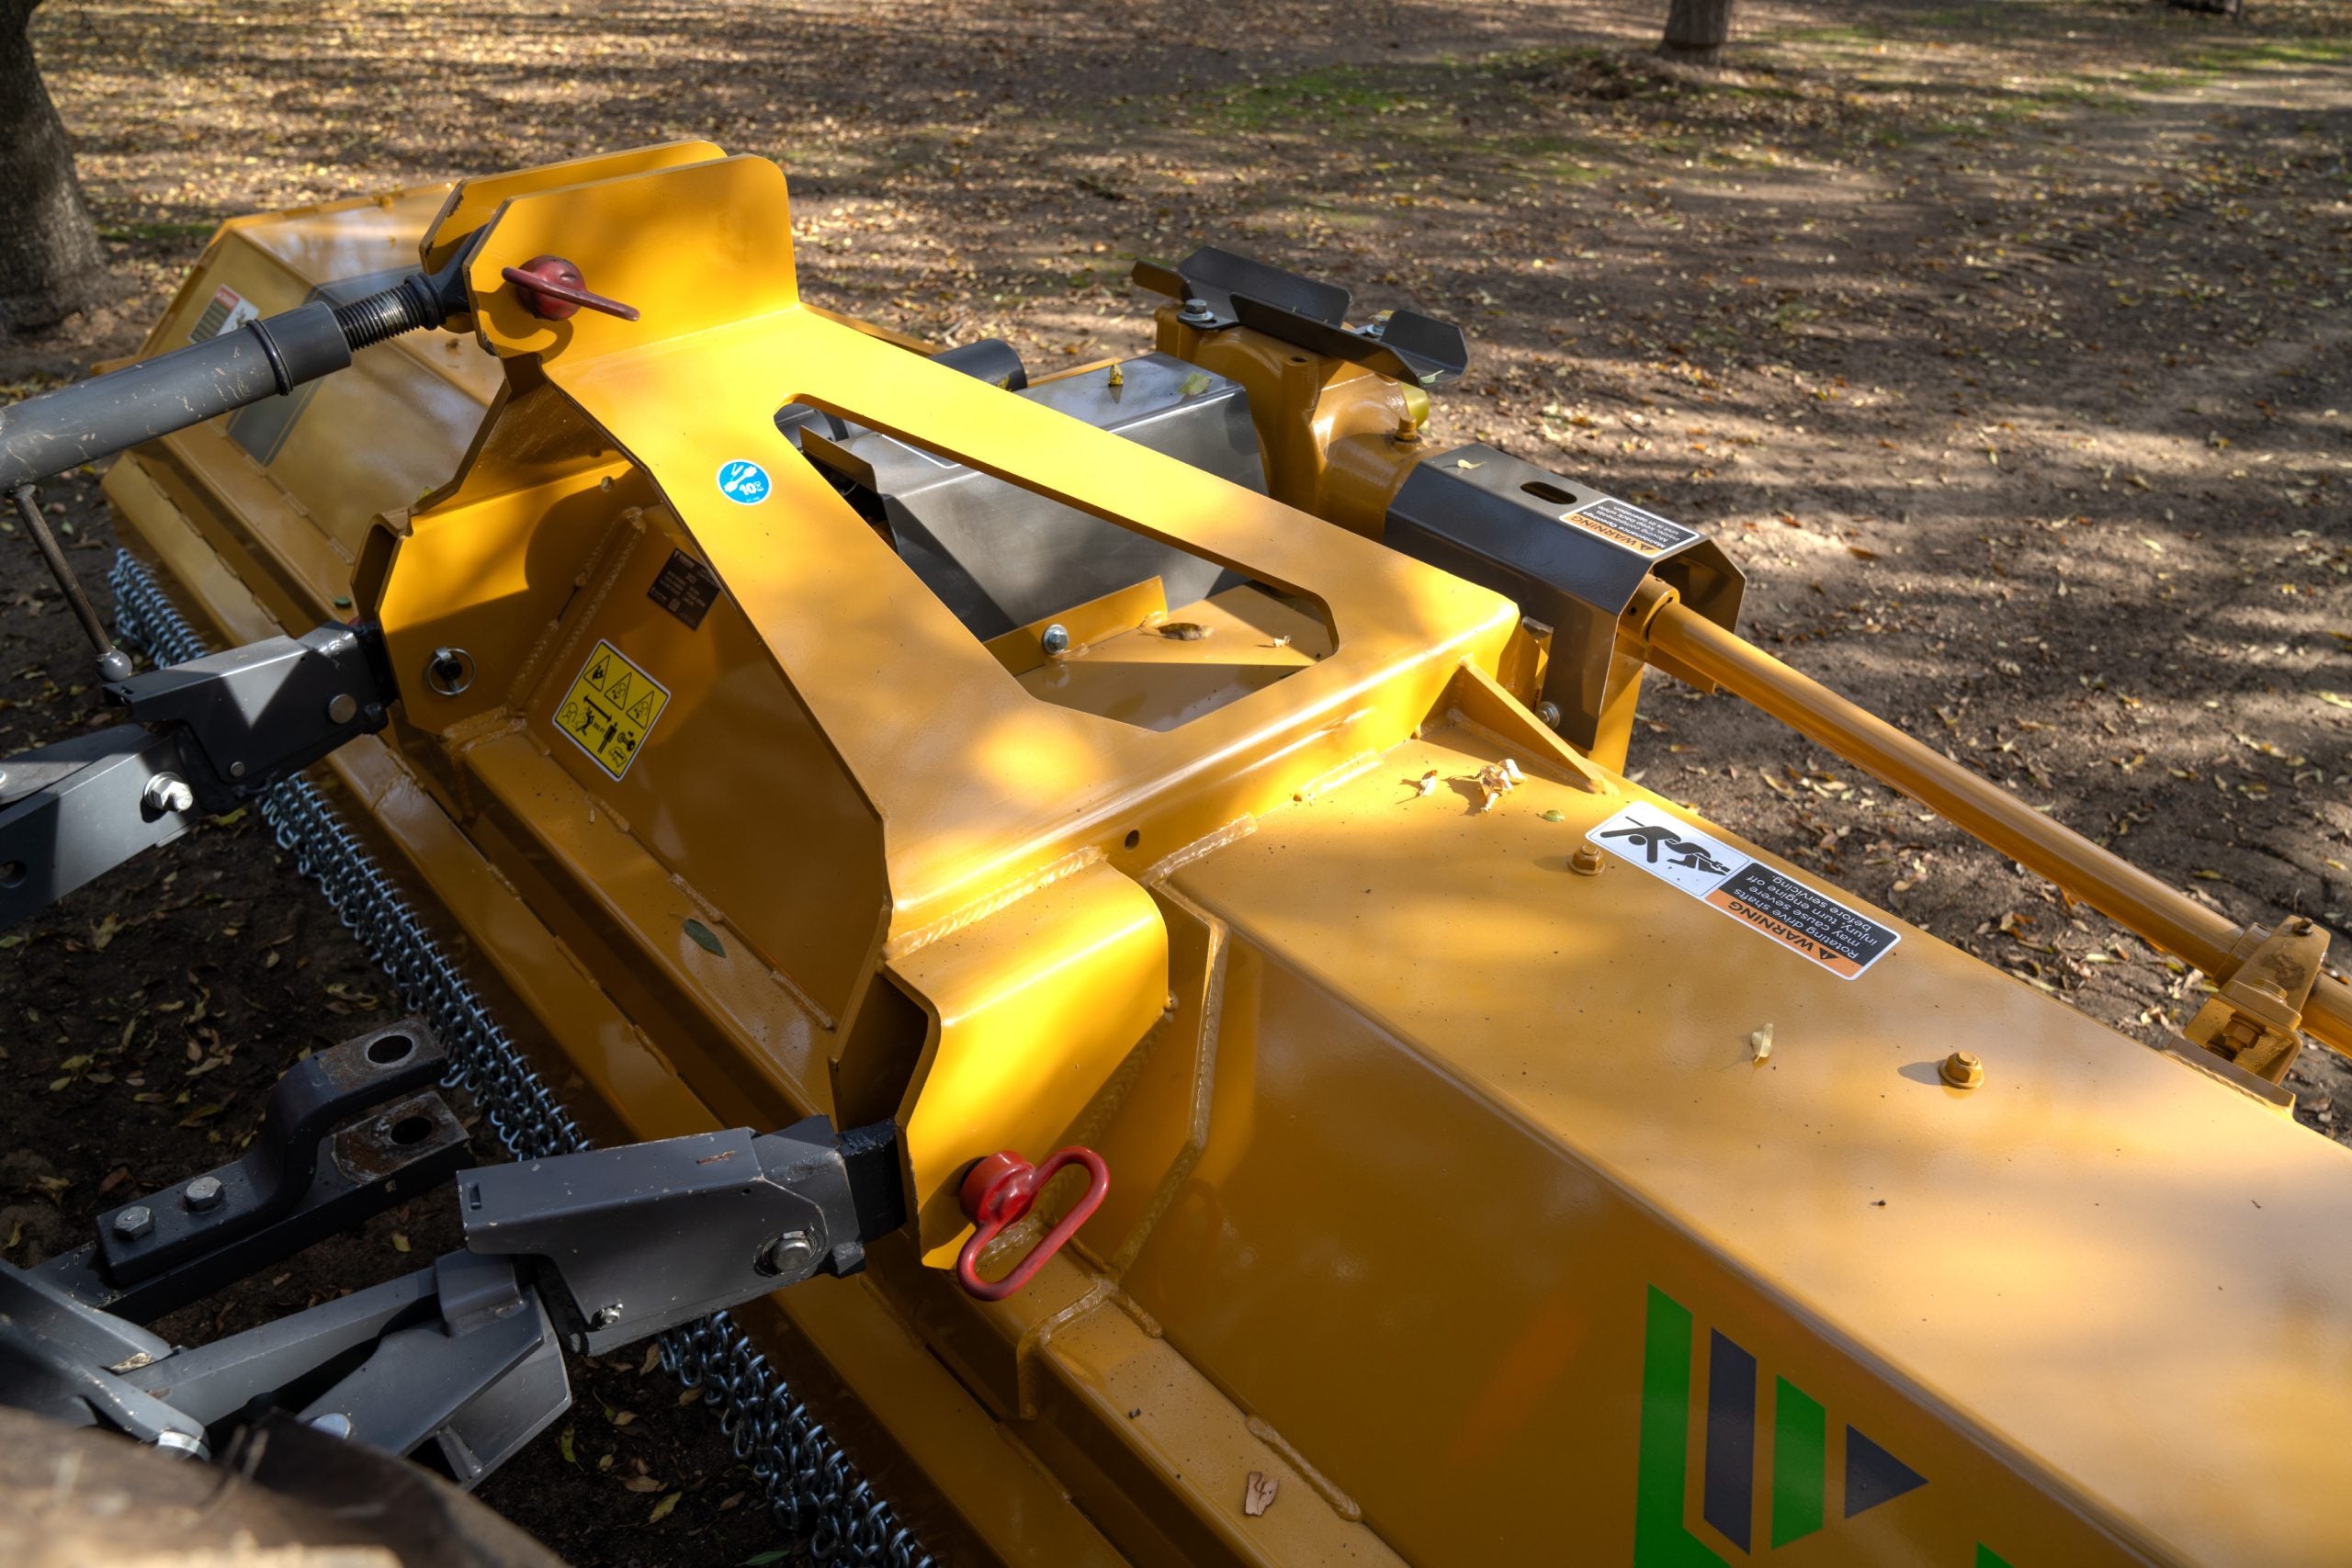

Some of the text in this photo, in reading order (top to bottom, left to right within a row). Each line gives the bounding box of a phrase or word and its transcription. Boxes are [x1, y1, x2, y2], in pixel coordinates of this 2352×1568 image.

[1571, 515, 1637, 546] WARNING
[1582, 511, 1666, 548] Maintenance Openings
[1596, 510, 1668, 542] Moving components
[1618, 513, 1636, 525] back
[1636, 521, 1655, 534] keep
[1745, 874, 1765, 886] off
[1767, 884, 1809, 910] engine
[1770, 874, 1872, 931] before servicing.
[1728, 901, 1815, 952] WARNING
[1734, 888, 1860, 960] Rotating drive shafts
[1748, 886, 1860, 947] may cause severe
[1811, 908, 1837, 927] turn
